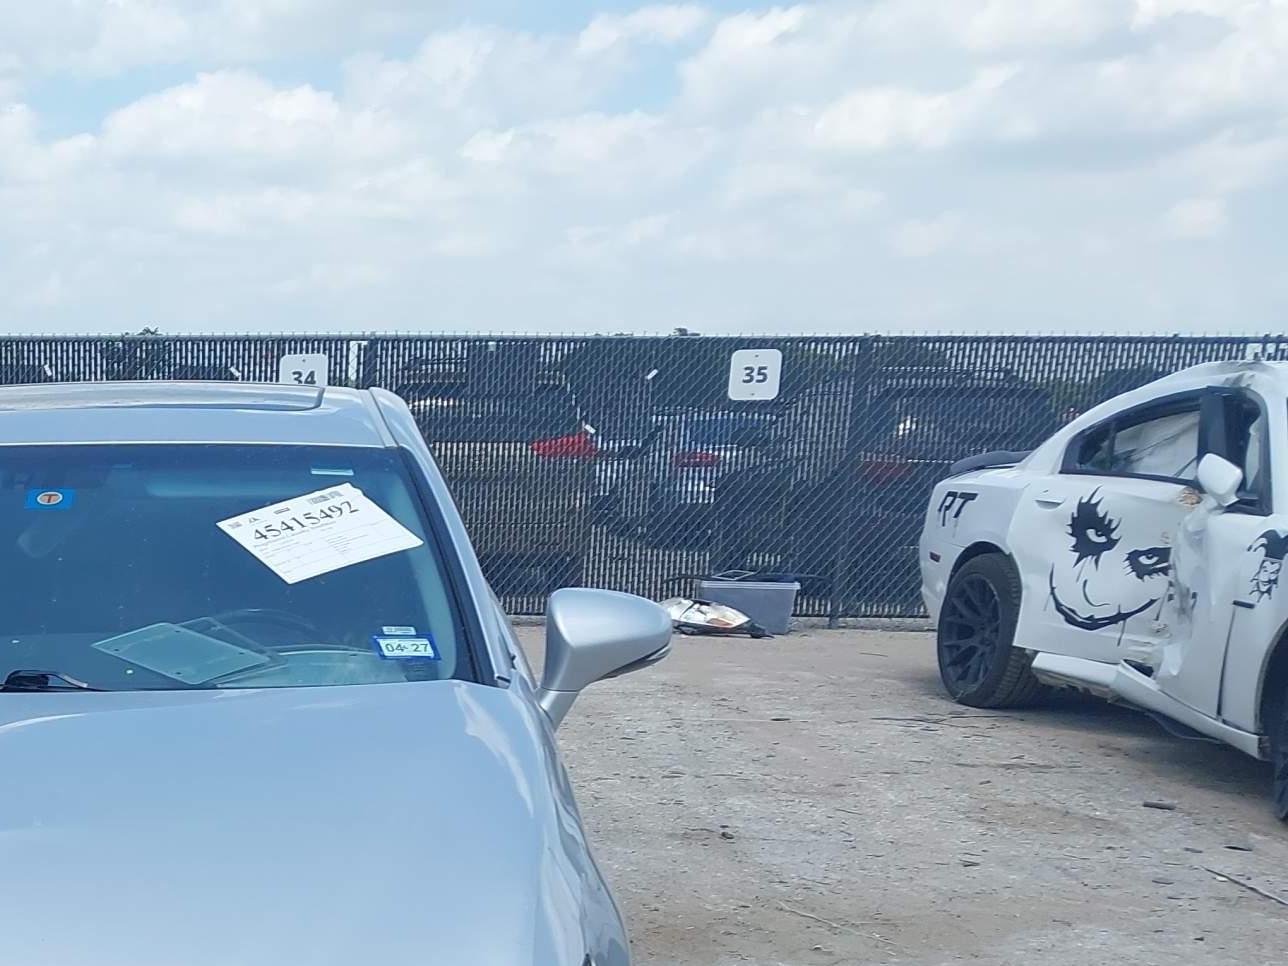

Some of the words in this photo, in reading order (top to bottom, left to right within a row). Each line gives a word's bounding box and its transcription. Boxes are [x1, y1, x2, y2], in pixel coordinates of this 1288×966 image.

[292, 370, 317, 385] 34
[742, 366, 769, 384] 35
[253, 500, 360, 540] 45415492
